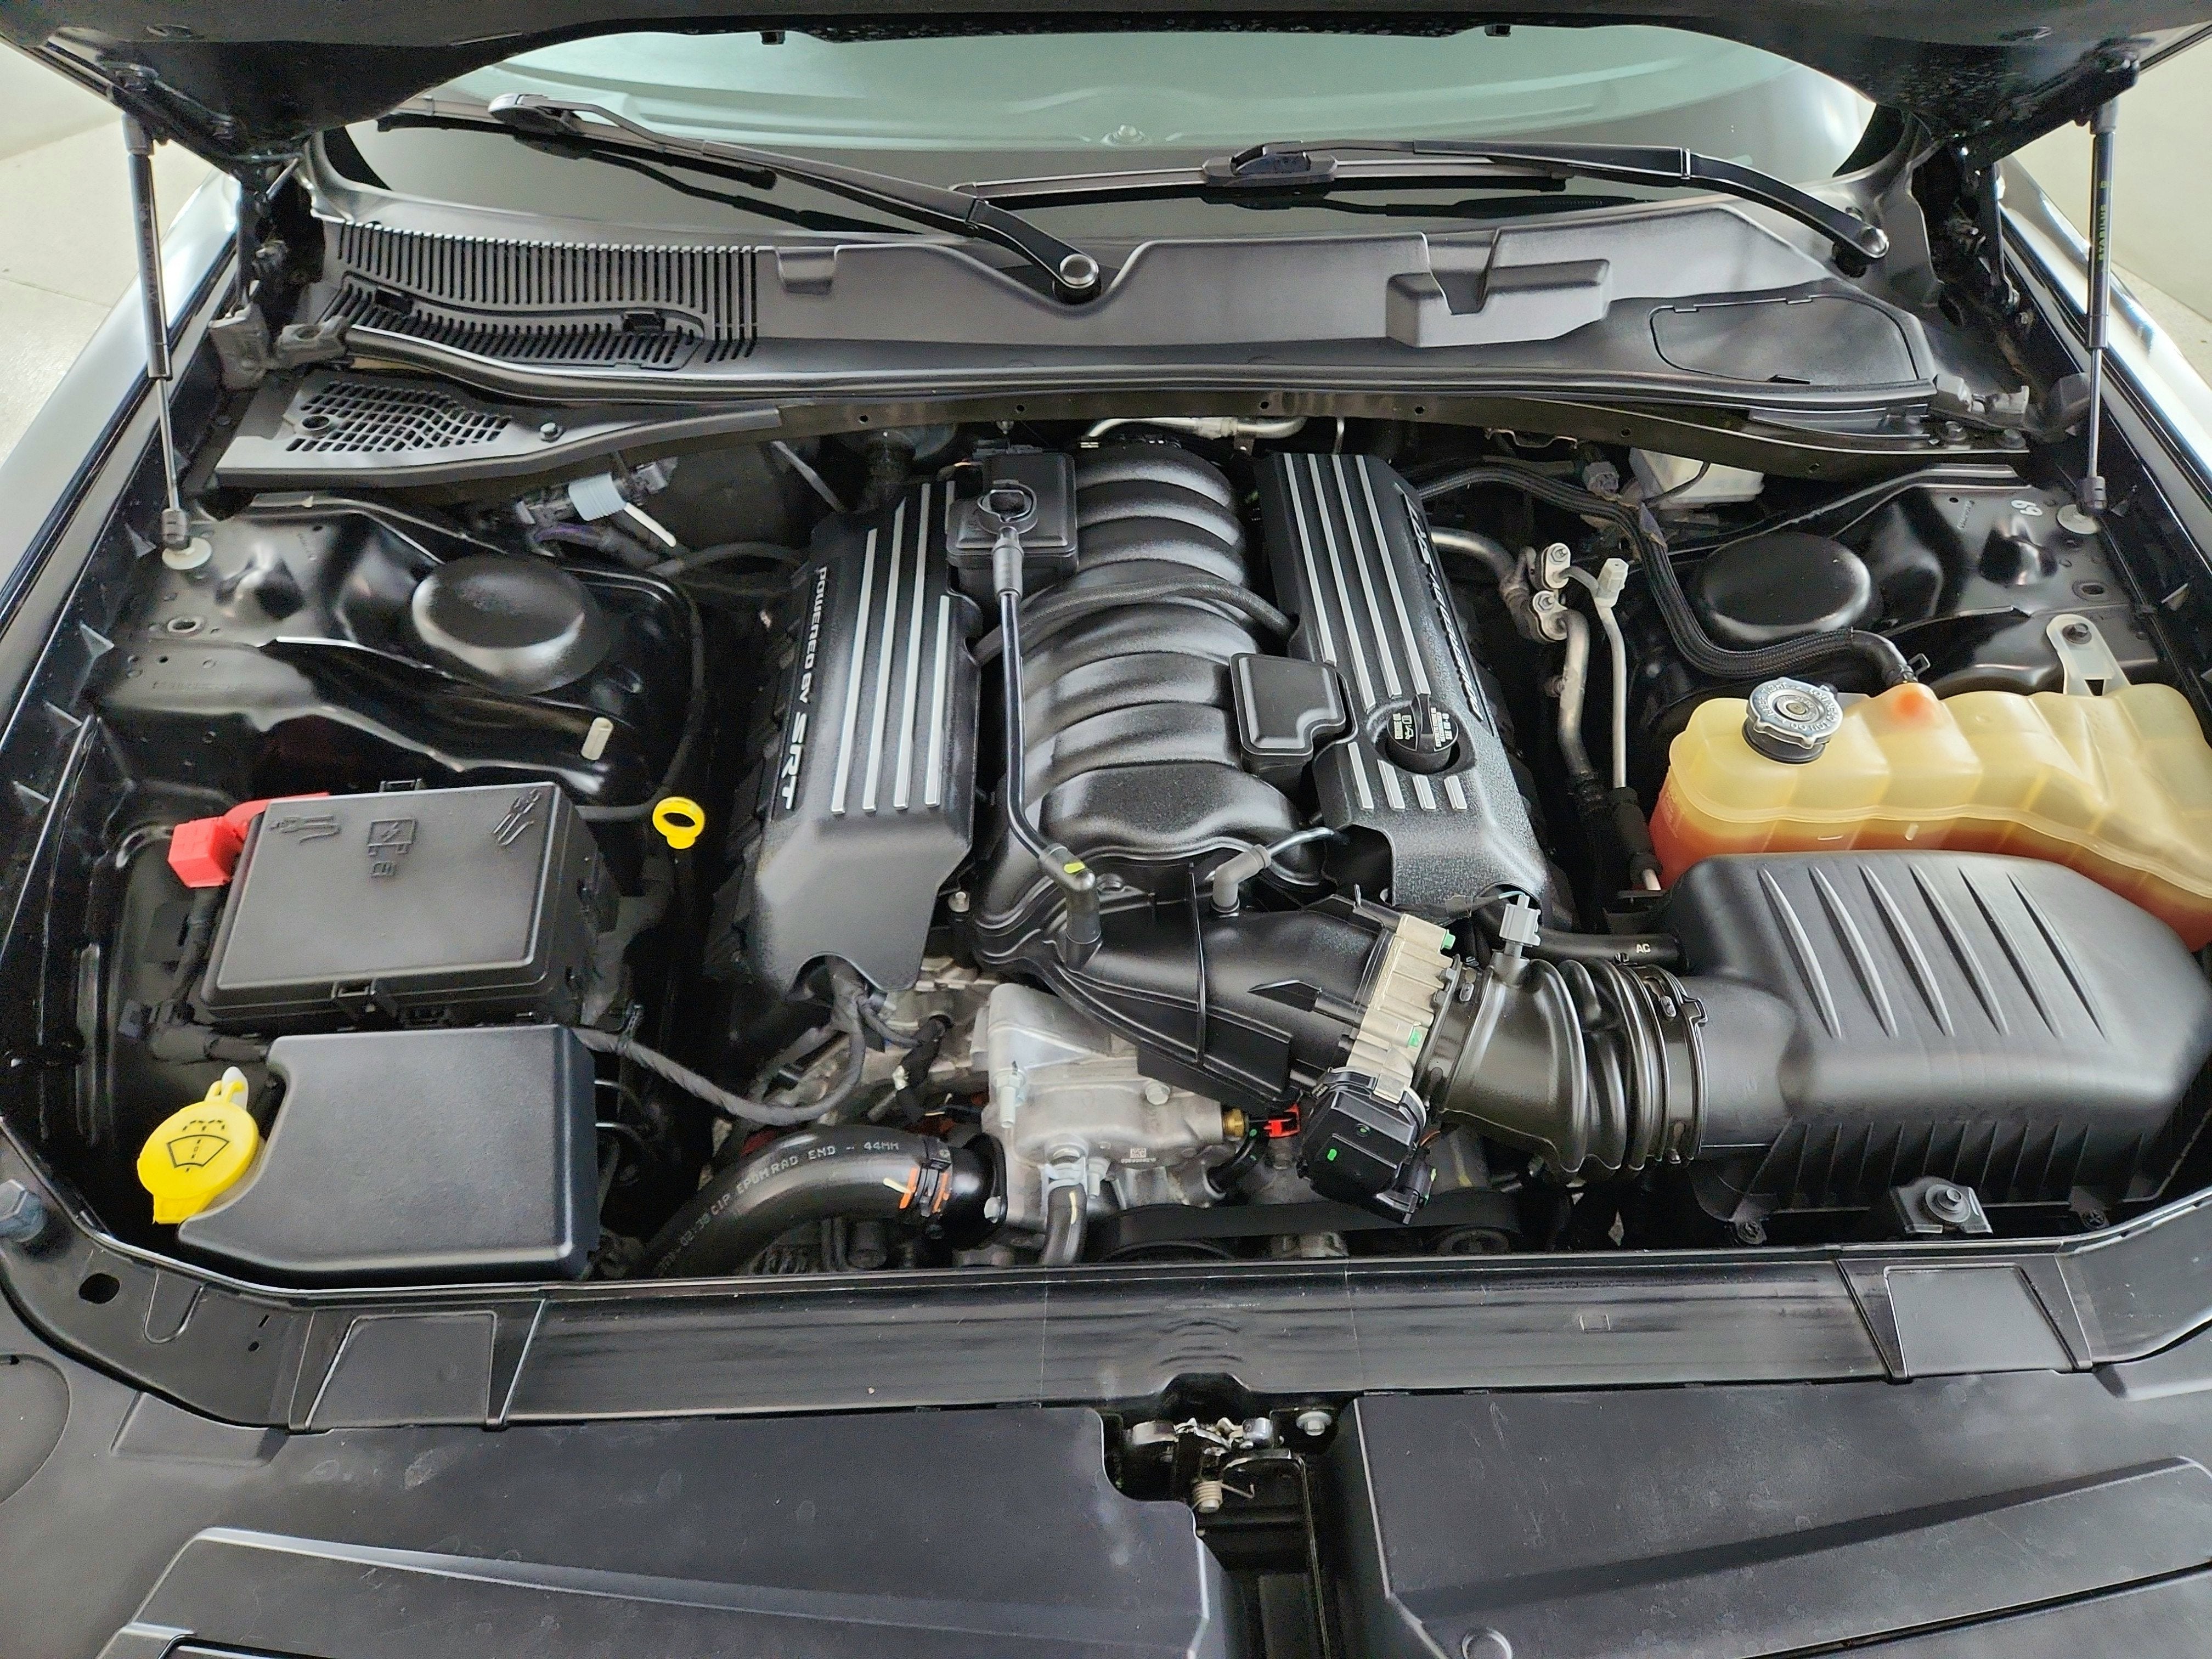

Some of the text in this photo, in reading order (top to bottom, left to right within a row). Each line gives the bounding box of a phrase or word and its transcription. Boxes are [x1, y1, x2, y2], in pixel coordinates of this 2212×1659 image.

[1428, 572, 1446, 606] BY
[1438, 604, 1483, 720] POWERED
[781, 566, 827, 810] POWERED BY SRT
[1636, 943, 1651, 953] AC
[808, 1144, 836, 1161] END
[863, 1141, 900, 1152] 44MM
